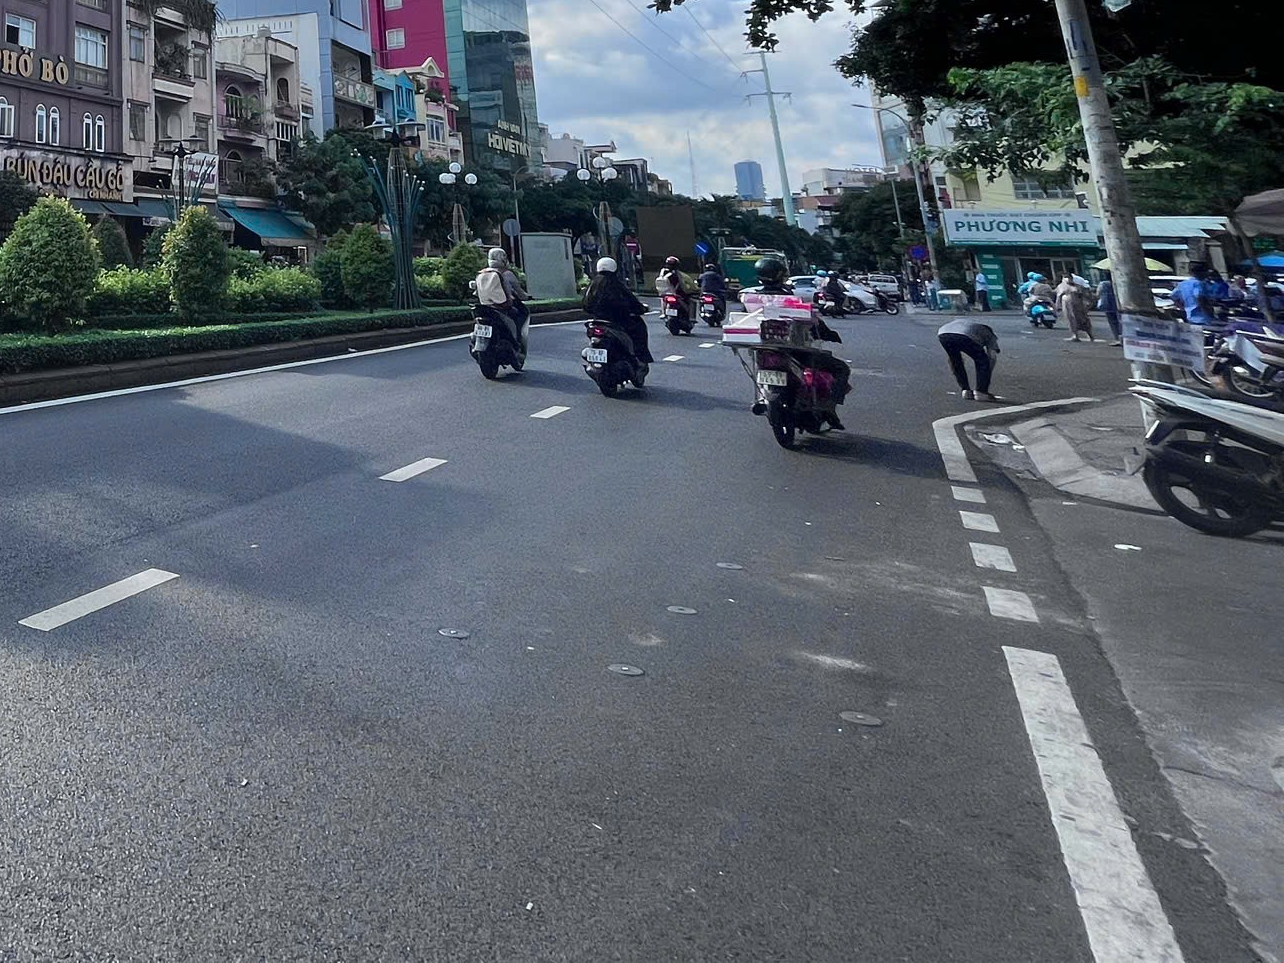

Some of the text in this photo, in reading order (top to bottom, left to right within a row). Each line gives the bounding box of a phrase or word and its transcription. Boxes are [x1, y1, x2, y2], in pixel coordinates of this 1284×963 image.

[41, 55, 69, 85] BÒ
[954, 218, 1089, 232] PHƯƠNG NHI
